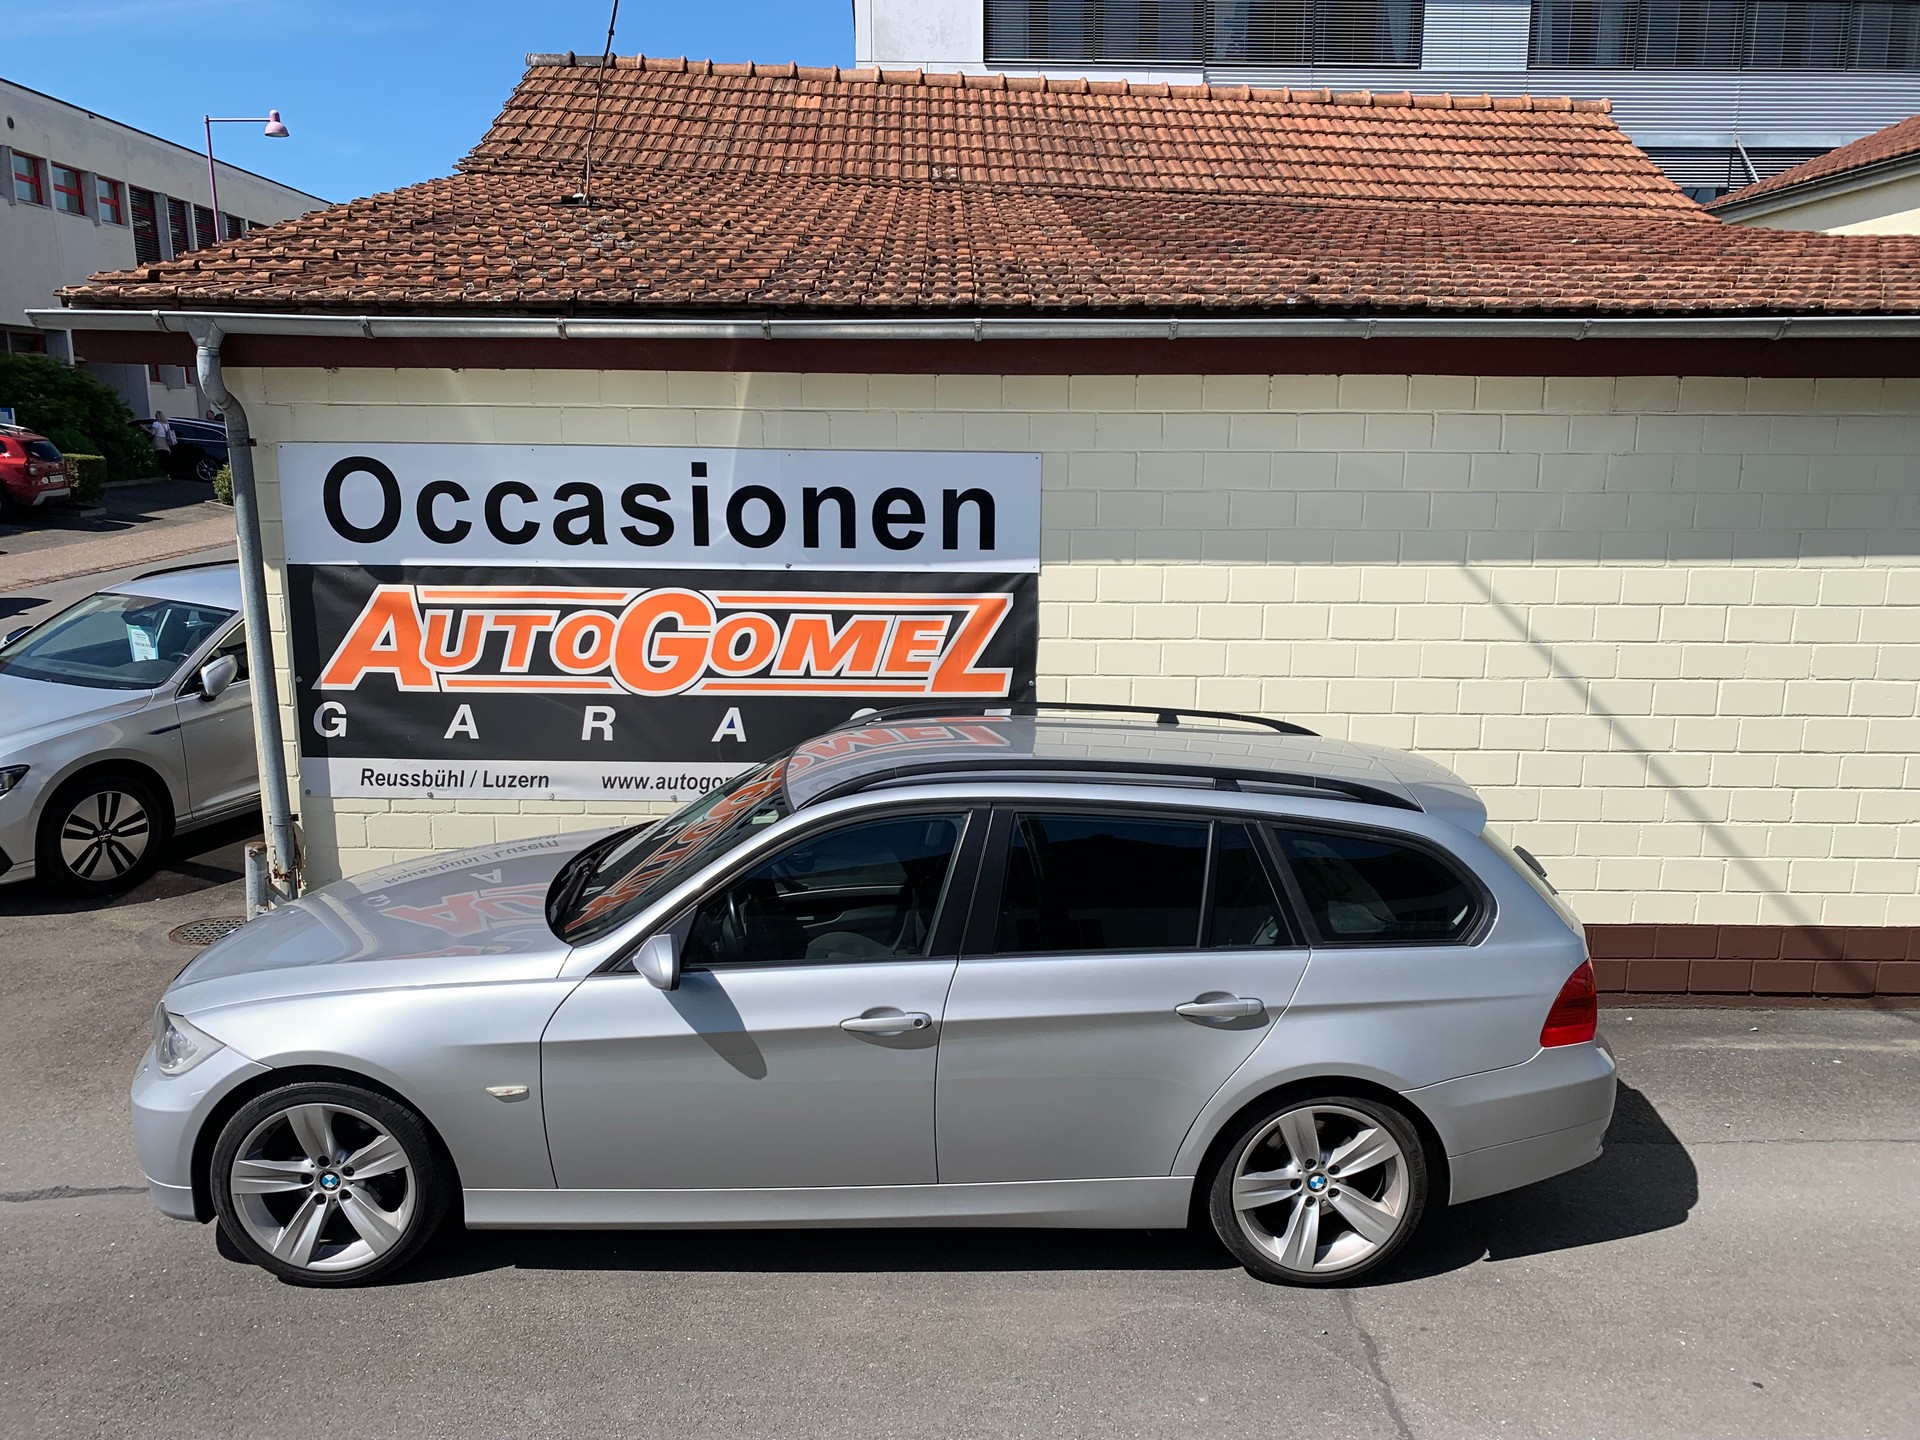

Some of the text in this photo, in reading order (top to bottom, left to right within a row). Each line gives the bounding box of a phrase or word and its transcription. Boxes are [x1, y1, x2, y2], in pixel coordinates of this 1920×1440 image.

[322, 455, 997, 551] Occasionen
[360, 767, 550, 788] Reussbühl / Luzern
[601, 772, 733, 795] www.autogo
